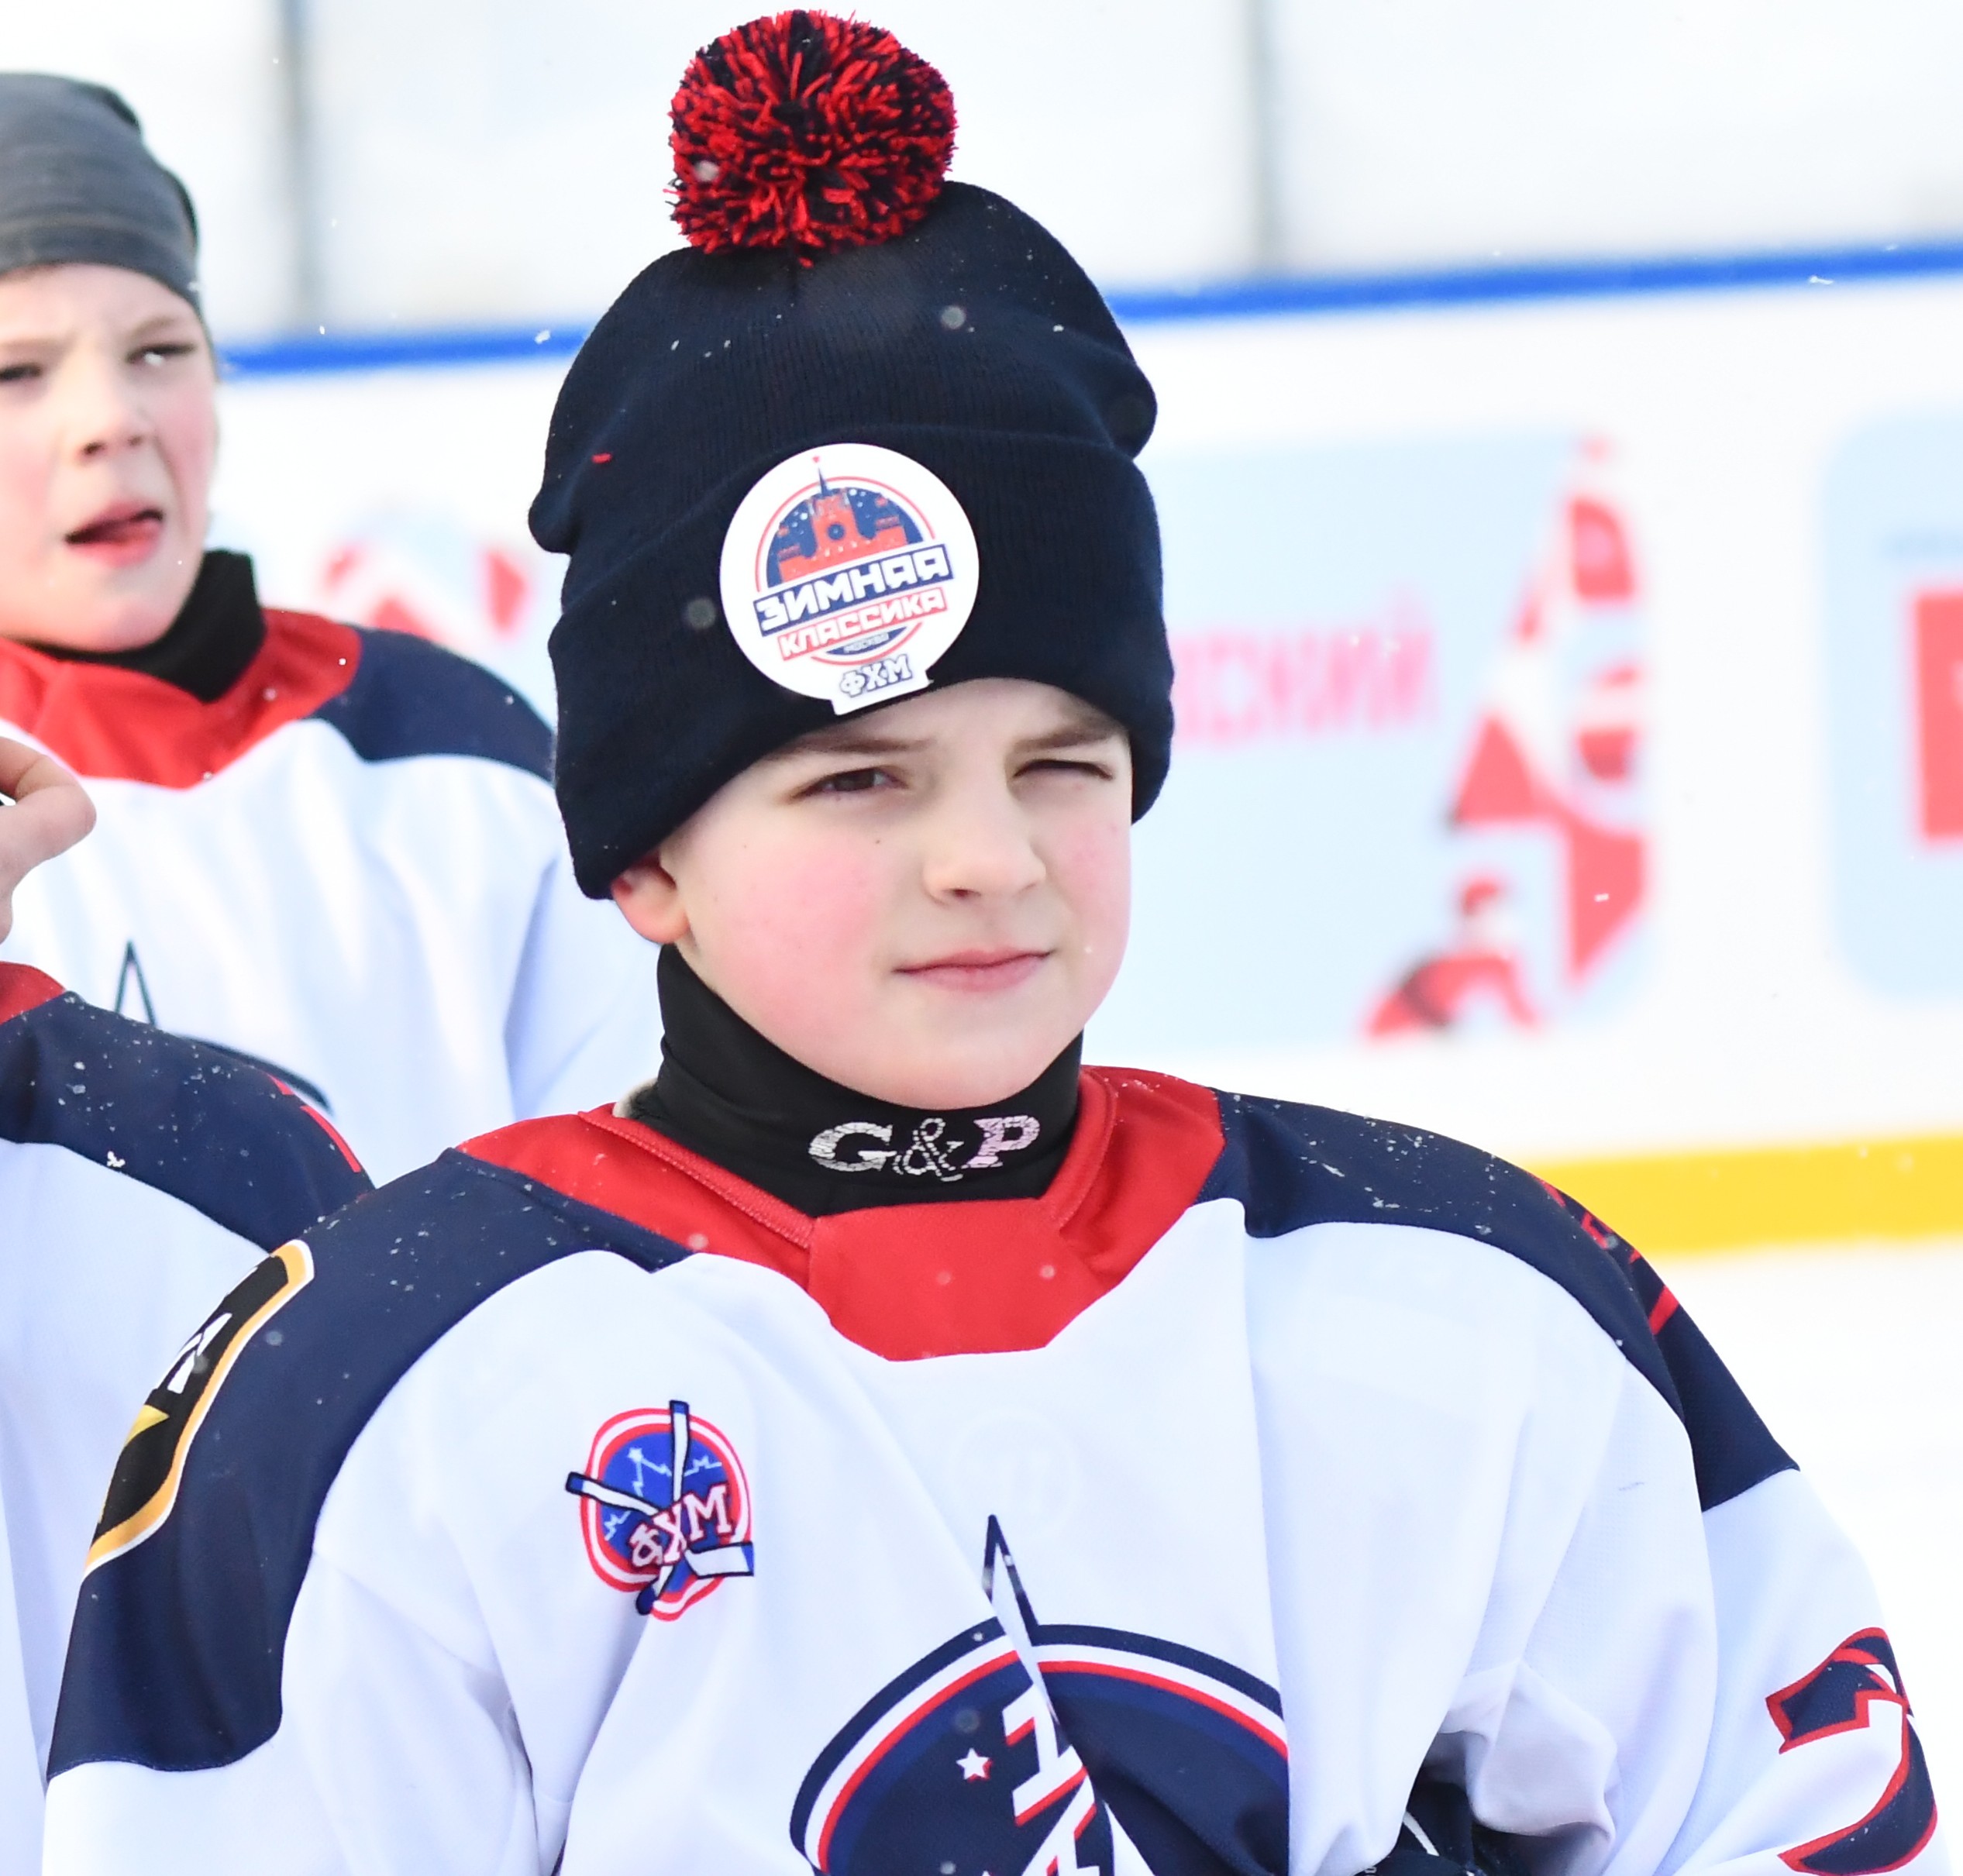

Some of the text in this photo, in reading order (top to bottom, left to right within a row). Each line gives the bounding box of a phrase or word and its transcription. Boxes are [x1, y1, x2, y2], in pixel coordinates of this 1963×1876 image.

[754, 545, 952, 635] ЗИМНЯЯ
[778, 587, 946, 659] КЛАССИКА
[839, 654, 912, 698] ФХМ
[808, 1115, 1040, 1182] G&P
[627, 1481, 735, 1568] ФХМ
